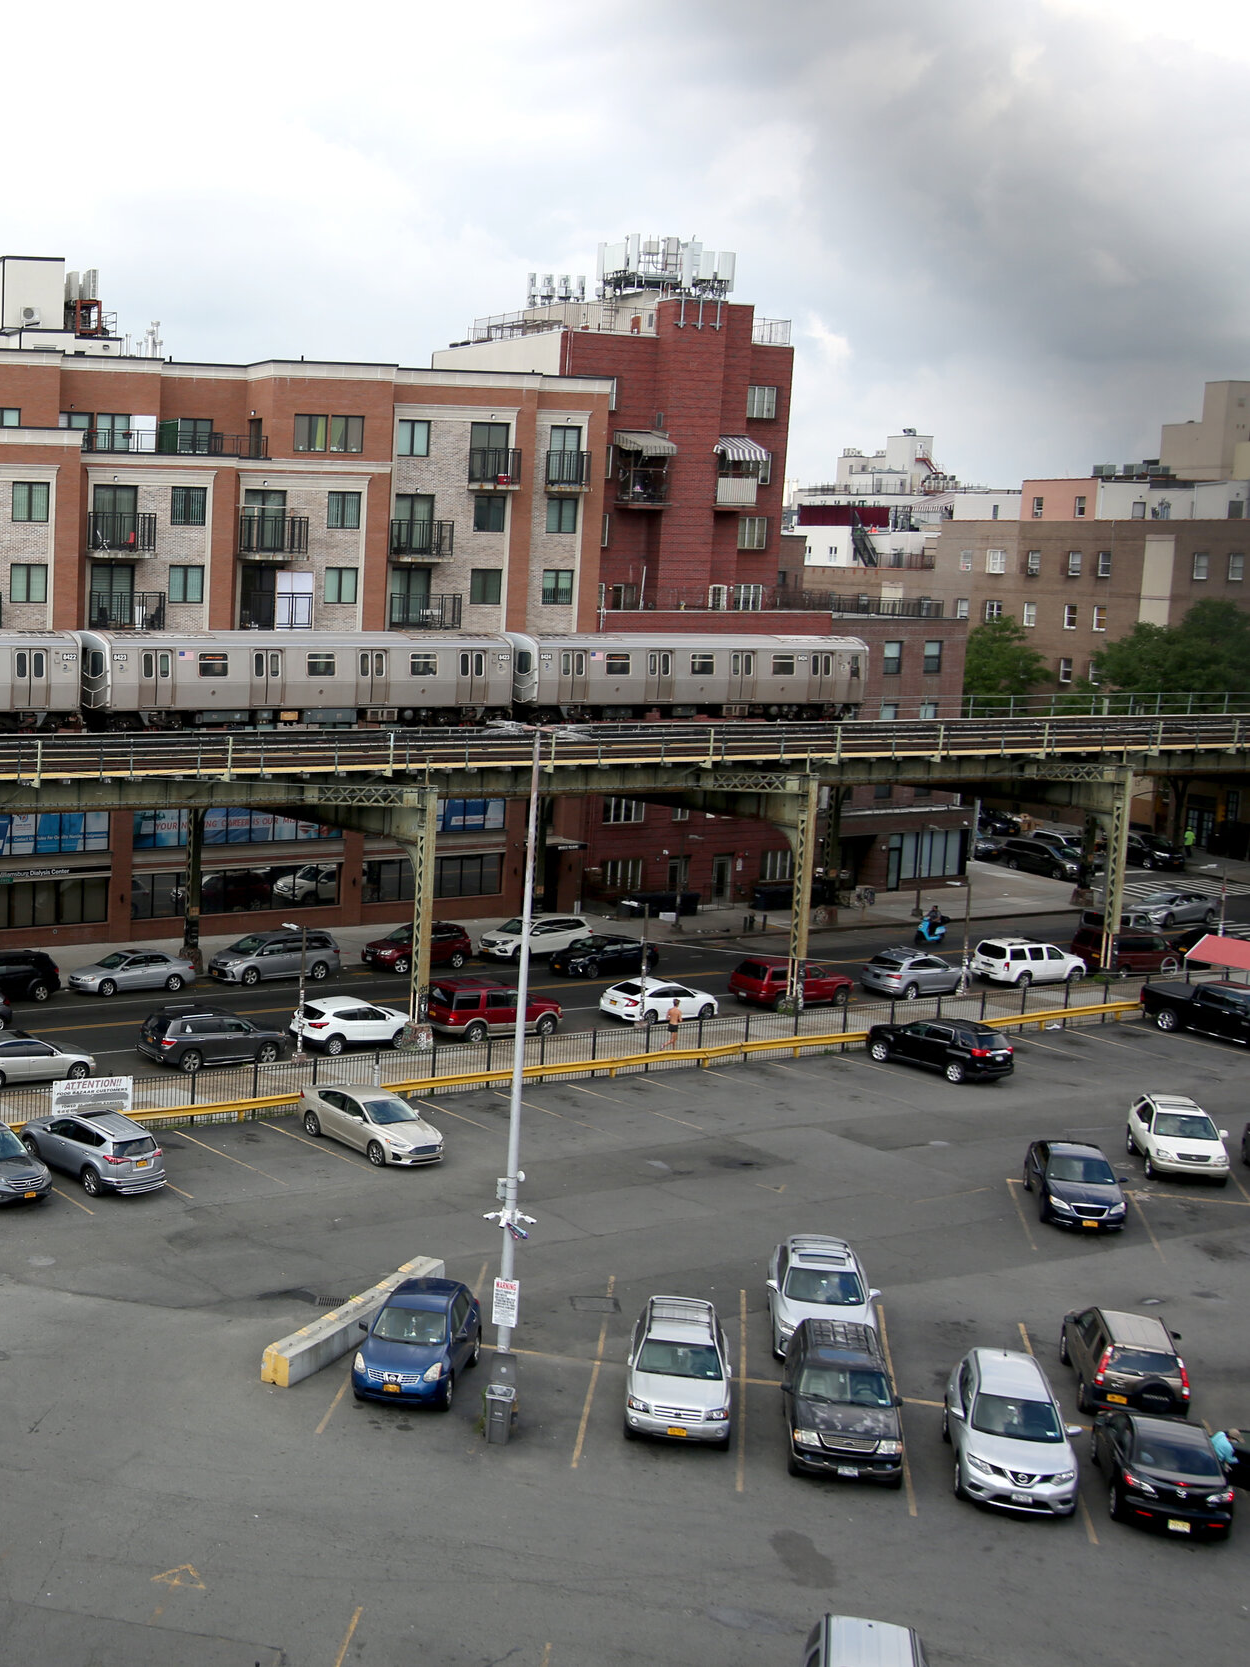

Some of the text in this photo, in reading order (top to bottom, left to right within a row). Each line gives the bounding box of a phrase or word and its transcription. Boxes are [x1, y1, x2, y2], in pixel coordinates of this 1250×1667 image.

[155, 821, 178, 830] YOUR
[222, 818, 250, 828] CAREER
[253, 817, 260, 825] IS
[262, 816, 279, 826] OUR
[30, 869, 50, 877] Dialysis
[64, 1079, 122, 1090] ATTENTION!!
[496, 1281, 516, 1291] WARNING
